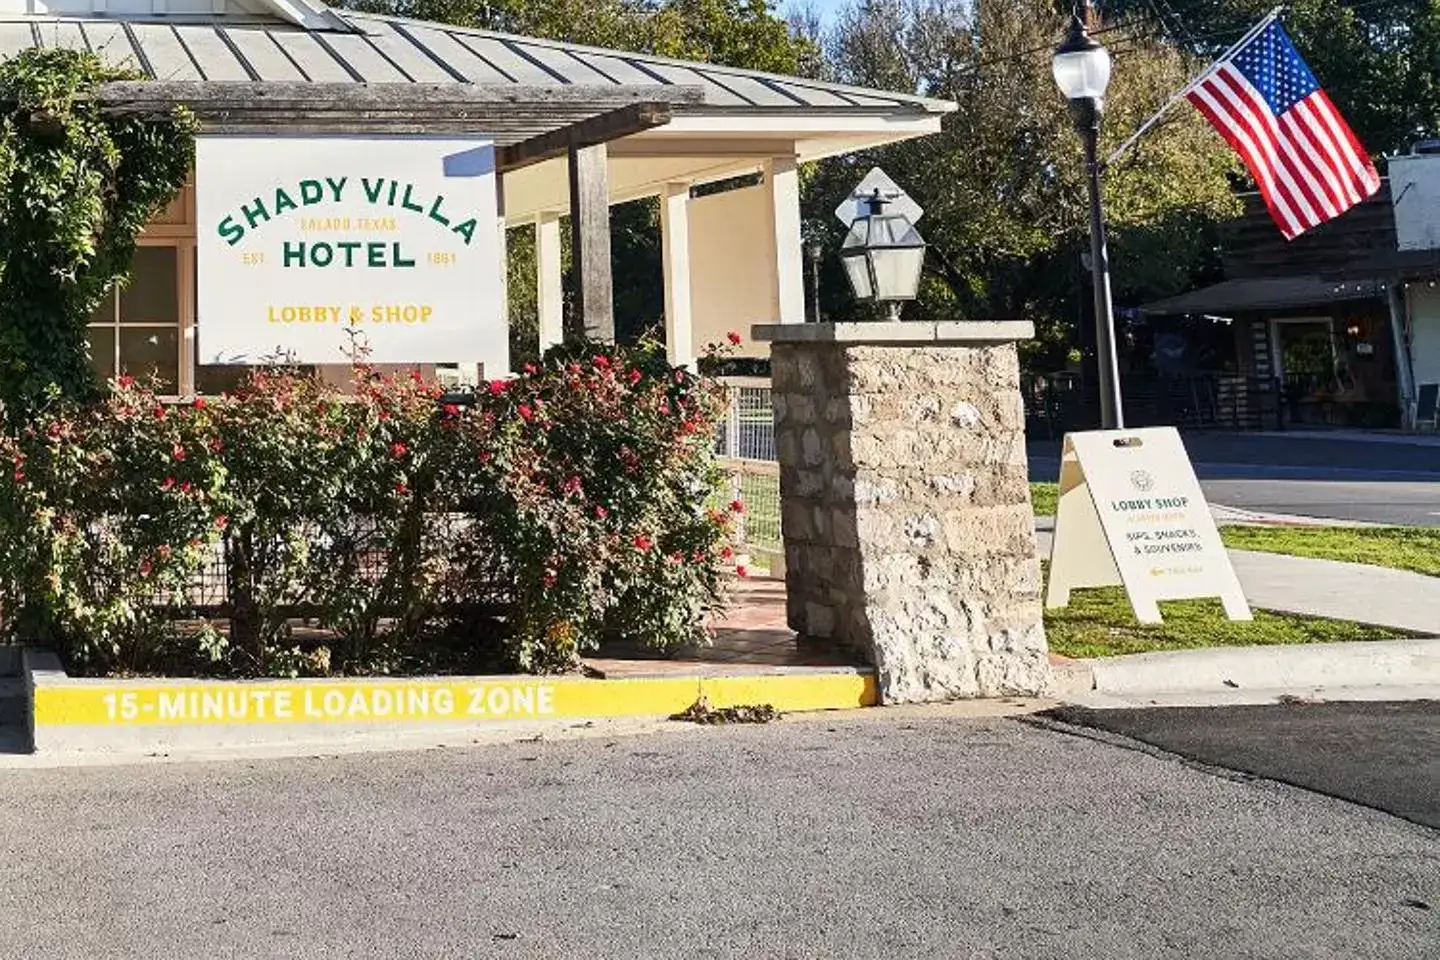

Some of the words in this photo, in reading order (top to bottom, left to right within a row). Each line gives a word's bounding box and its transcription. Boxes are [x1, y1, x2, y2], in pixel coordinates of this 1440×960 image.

[217, 177, 348, 246] SHADY
[361, 177, 479, 245] VILLA
[283, 242, 416, 268] HOTEL
[268, 306, 341, 323] LOBBY
[349, 306, 365, 323] &
[372, 306, 433, 323] SHOP
[1111, 498, 1152, 511] LOBBY
[1155, 497, 1189, 509] SHOP
[103, 689, 293, 720] 15-MINUTE
[304, 688, 455, 718] LOADING
[466, 686, 555, 715] ZONE
